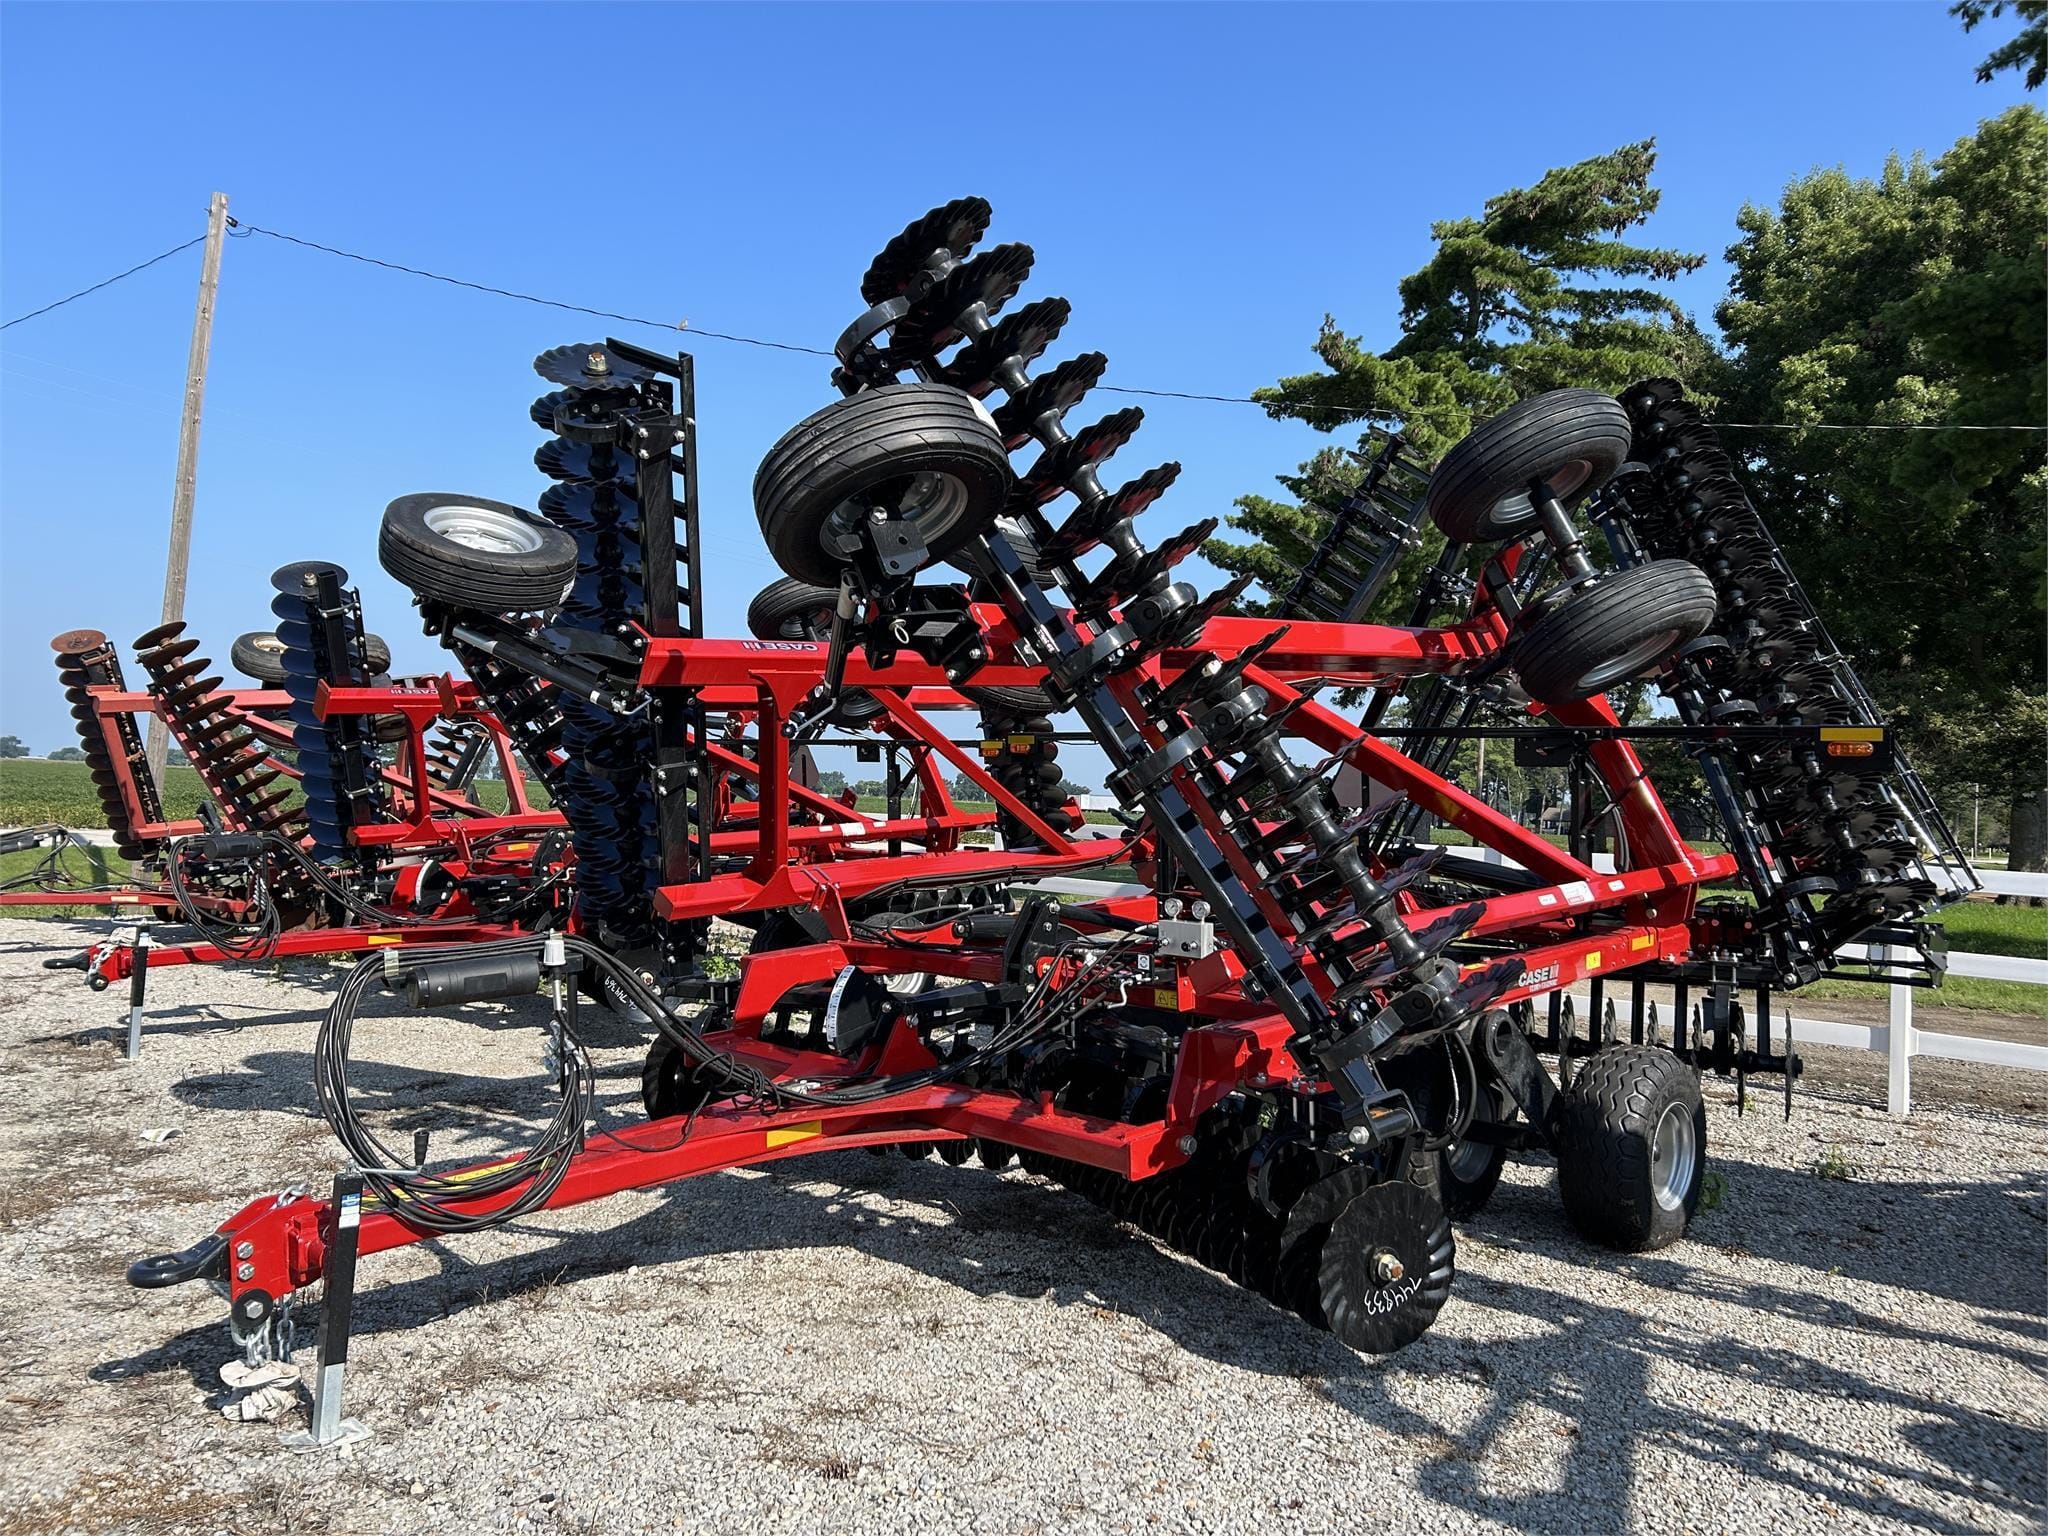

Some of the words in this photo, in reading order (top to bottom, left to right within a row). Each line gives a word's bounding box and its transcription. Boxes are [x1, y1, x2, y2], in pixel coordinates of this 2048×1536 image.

[762, 642, 818, 651] CASE
[1518, 967, 1549, 987] CASE
[1364, 1277, 1422, 1316] 744833
